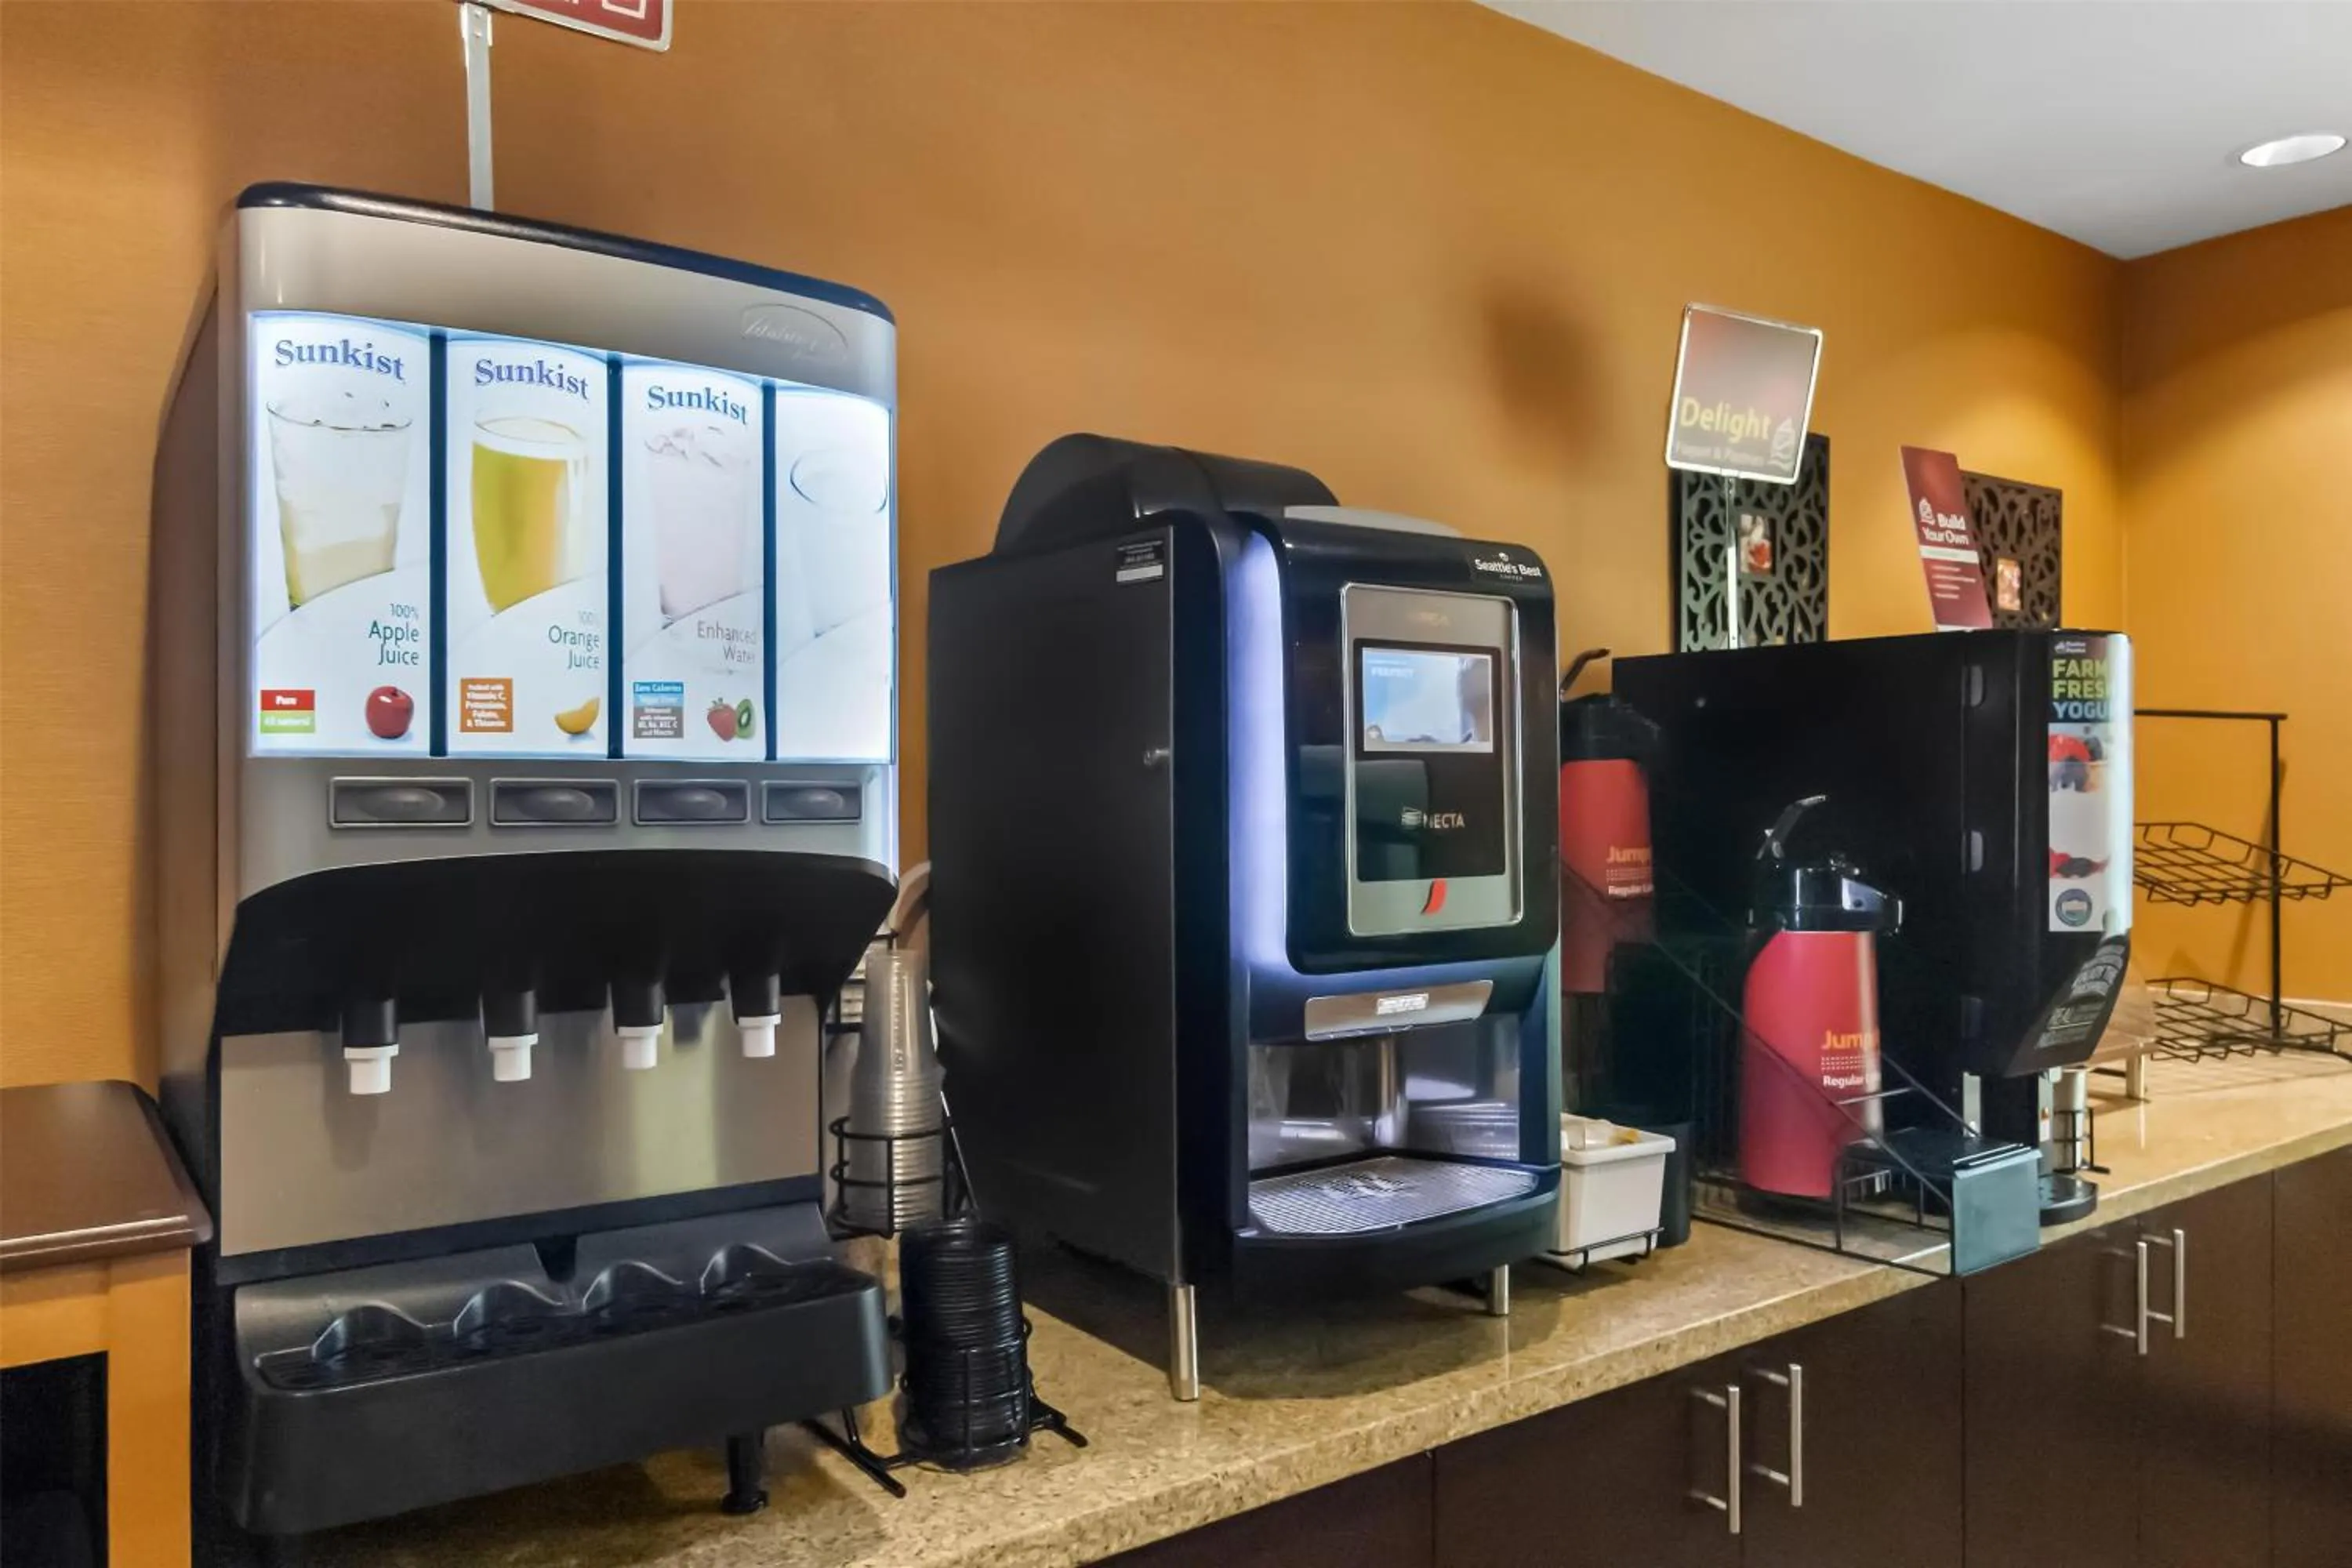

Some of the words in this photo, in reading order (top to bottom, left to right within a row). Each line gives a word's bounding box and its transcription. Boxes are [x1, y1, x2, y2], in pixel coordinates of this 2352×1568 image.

[275, 339, 405, 382] Sunkist
[474, 359, 590, 401] Sunkist
[647, 386, 749, 426] Sunkist
[1680, 397, 1772, 445] Delight
[1938, 513, 1966, 531] Build
[1922, 527, 1945, 543] Your
[1945, 530, 1970, 546] Own
[1475, 558, 1518, 575] Seattle's
[1519, 563, 1542, 577] Best
[368, 620, 419, 645] Apple
[549, 625, 600, 652] Orange
[697, 620, 757, 645] Enhanced
[378, 644, 419, 666] Juice
[568, 650, 600, 670] Juice
[723, 644, 756, 665] Water
[2053, 701, 2111, 720] YOGU
[1822, 1073, 1864, 1089] Regular
